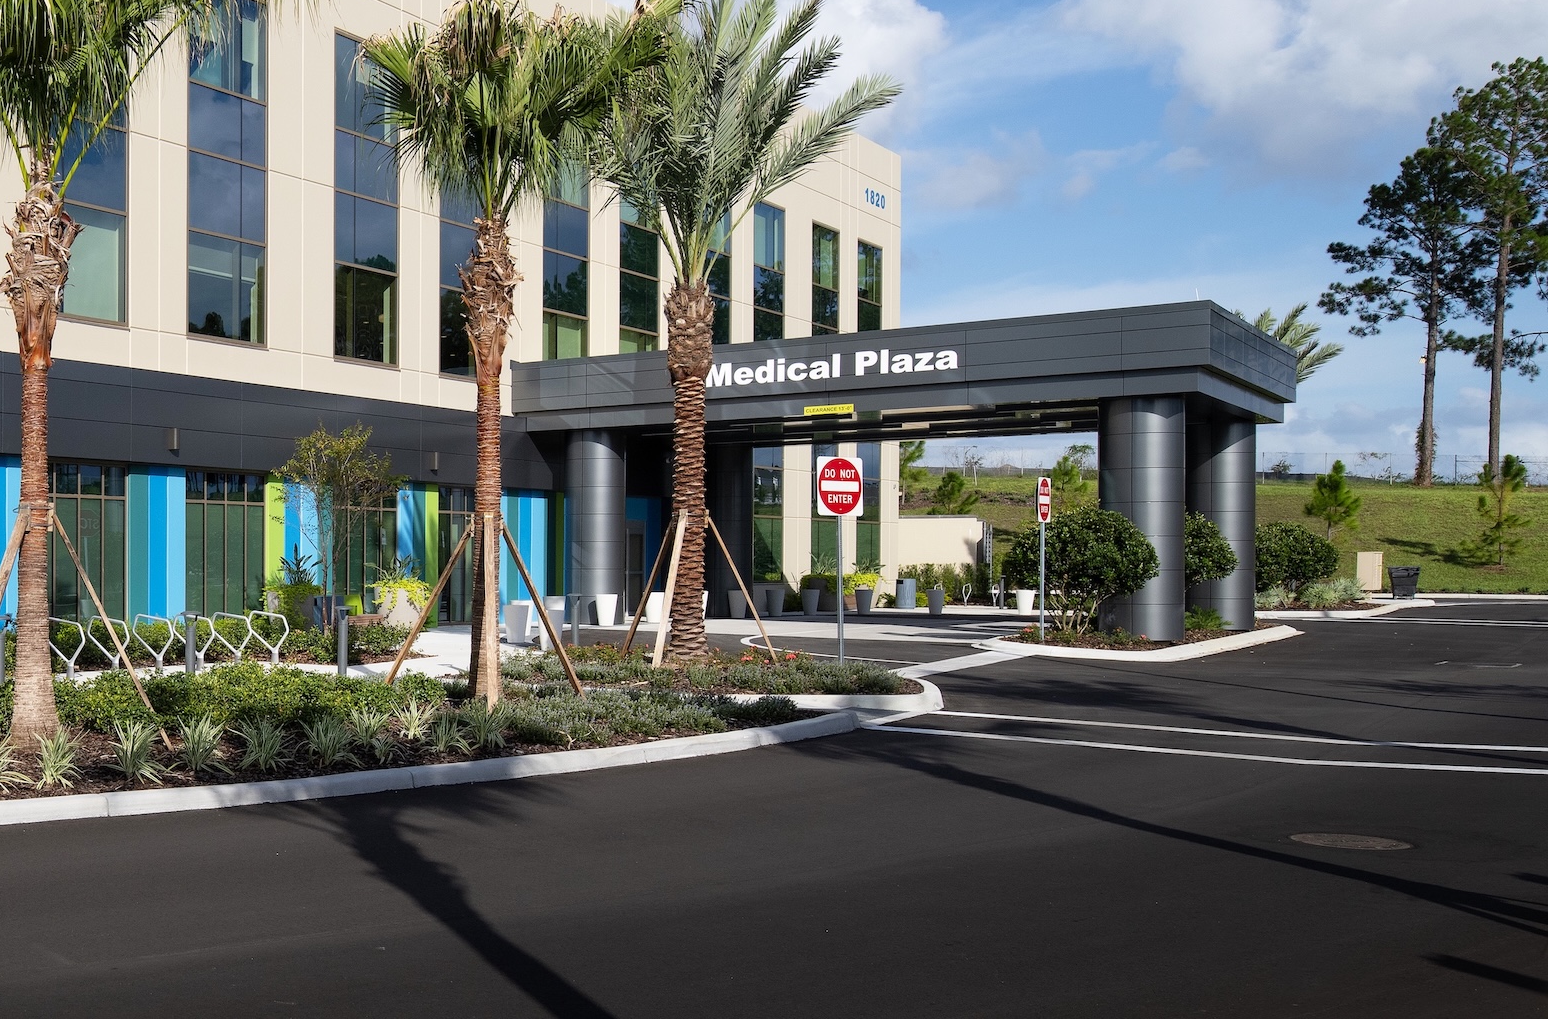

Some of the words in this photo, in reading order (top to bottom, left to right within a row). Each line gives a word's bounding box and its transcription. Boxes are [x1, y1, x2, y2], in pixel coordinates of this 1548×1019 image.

[864, 187, 886, 210] 1820
[705, 353, 841, 388] Medical
[854, 348, 959, 377] Plaza
[805, 406, 837, 414] CLEARANCE
[824, 468, 836, 478] DO
[839, 469, 856, 479] NOT
[827, 493, 853, 504] ENTER
